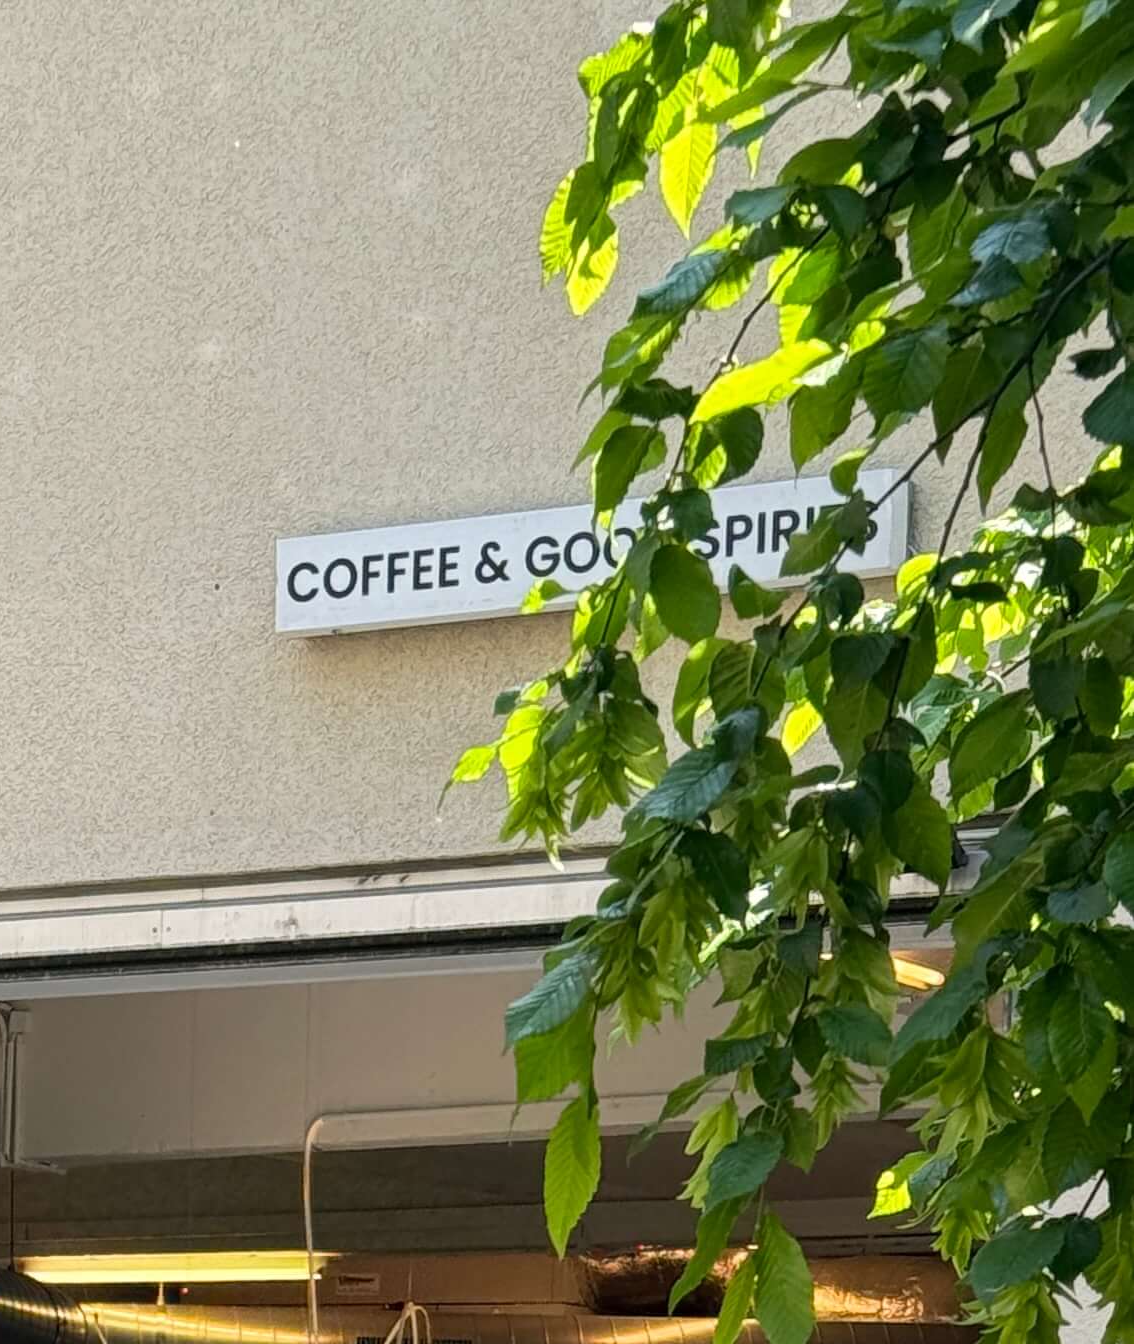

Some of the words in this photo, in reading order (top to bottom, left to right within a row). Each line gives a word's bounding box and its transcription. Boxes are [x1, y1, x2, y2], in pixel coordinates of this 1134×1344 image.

[287, 546, 460, 602] COFFEE
[474, 541, 511, 584] &
[524, 527, 638, 578] GOO
